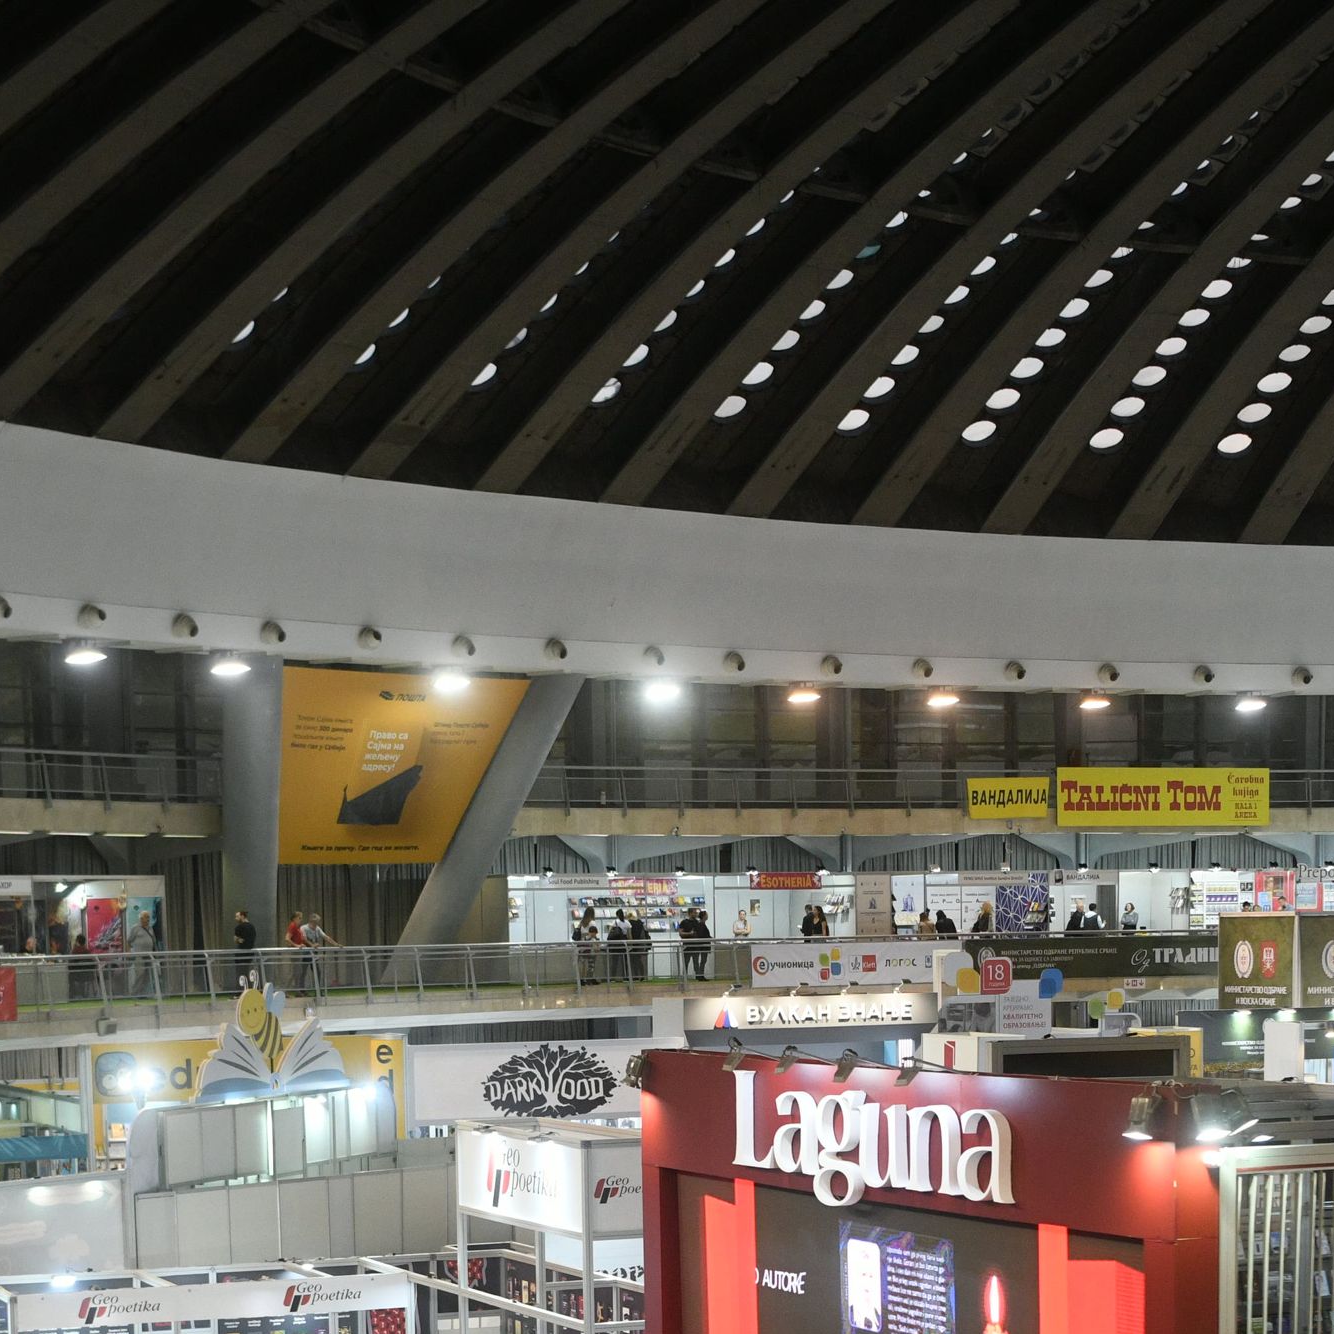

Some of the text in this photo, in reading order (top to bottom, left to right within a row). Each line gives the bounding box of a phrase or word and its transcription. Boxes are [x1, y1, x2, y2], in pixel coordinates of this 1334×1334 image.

[369, 730, 409, 740] Право са
[367, 741, 404, 752] Сајма на
[364, 753, 401, 763] жељену
[361, 763, 396, 772] адресу!
[1227, 772, 1264, 785] Čarobna
[1232, 786, 1259, 799] knjiga
[971, 789, 1047, 808] ВАНДАЛИЈА
[559, 877, 569, 885] Food
[760, 874, 813, 888] ESOTHERIA
[987, 964, 1005, 980] 18
[1224, 986, 1263, 994] МИНИСТАРСТВО
[746, 1002, 913, 1024] ВУЛКАН ЗНАЊЕ
[1003, 1021, 1046, 1029] ОБРАЗОВАЊЕ!
[732, 1070, 1016, 1206] Laguna
[606, 1175, 630, 1186] Geo
[296, 1282, 323, 1293] Geo
[92, 1294, 118, 1305] Geo
[310, 1289, 362, 1305] poetika
[107, 1300, 161, 1318] poetika
